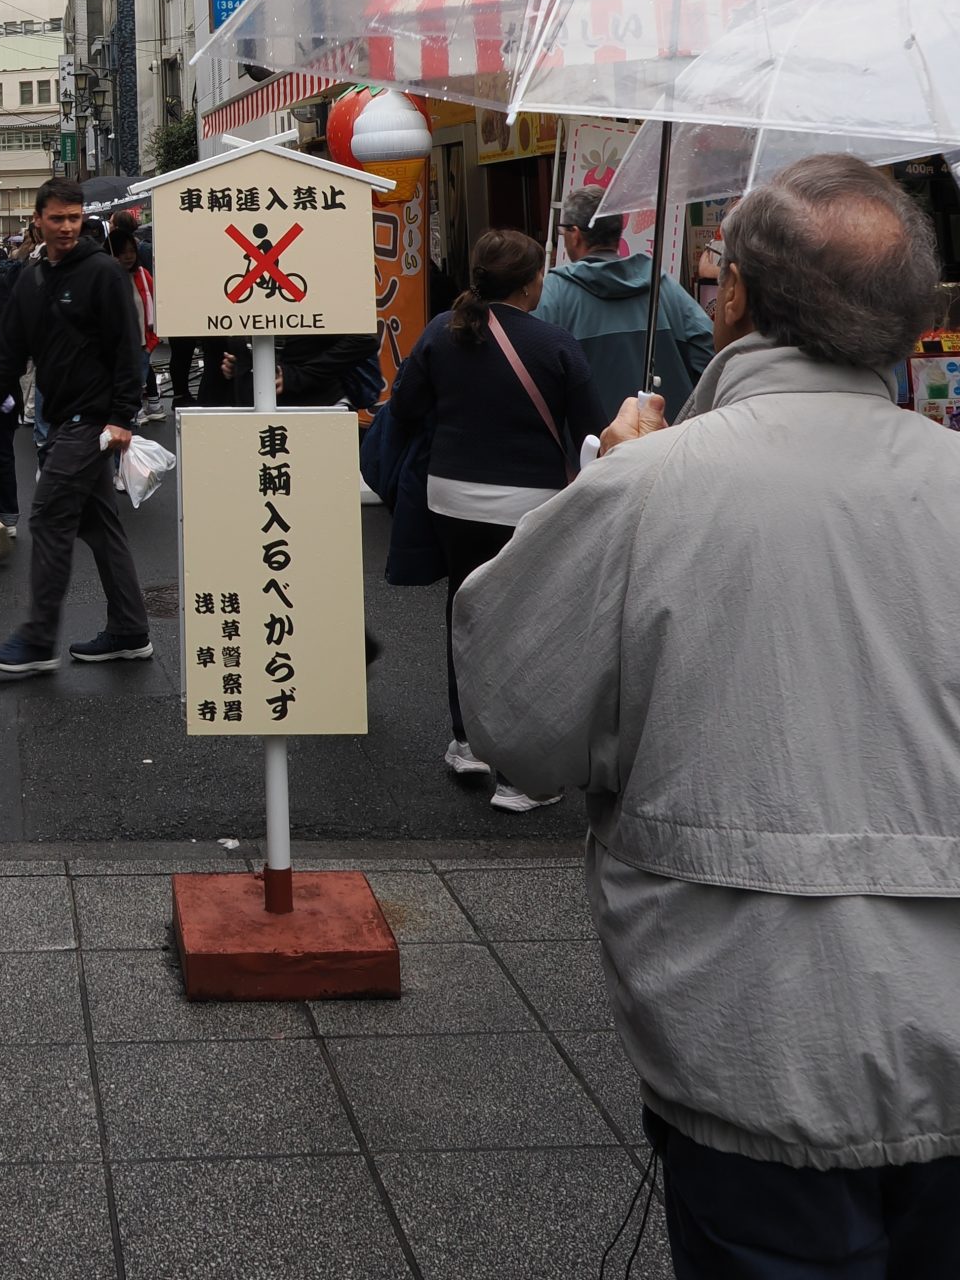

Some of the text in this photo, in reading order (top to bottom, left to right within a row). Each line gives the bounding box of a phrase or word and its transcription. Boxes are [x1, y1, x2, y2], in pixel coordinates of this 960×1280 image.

[217, 0, 244, 9] (384
[179, 186, 347, 213] 車輌進入禁止
[207, 313, 326, 330] NO VEHICLE
[258, 424, 297, 722] 車輌入るべからず
[194, 592, 217, 723] 浅草寺
[219, 592, 243, 723] 浅草警察署
